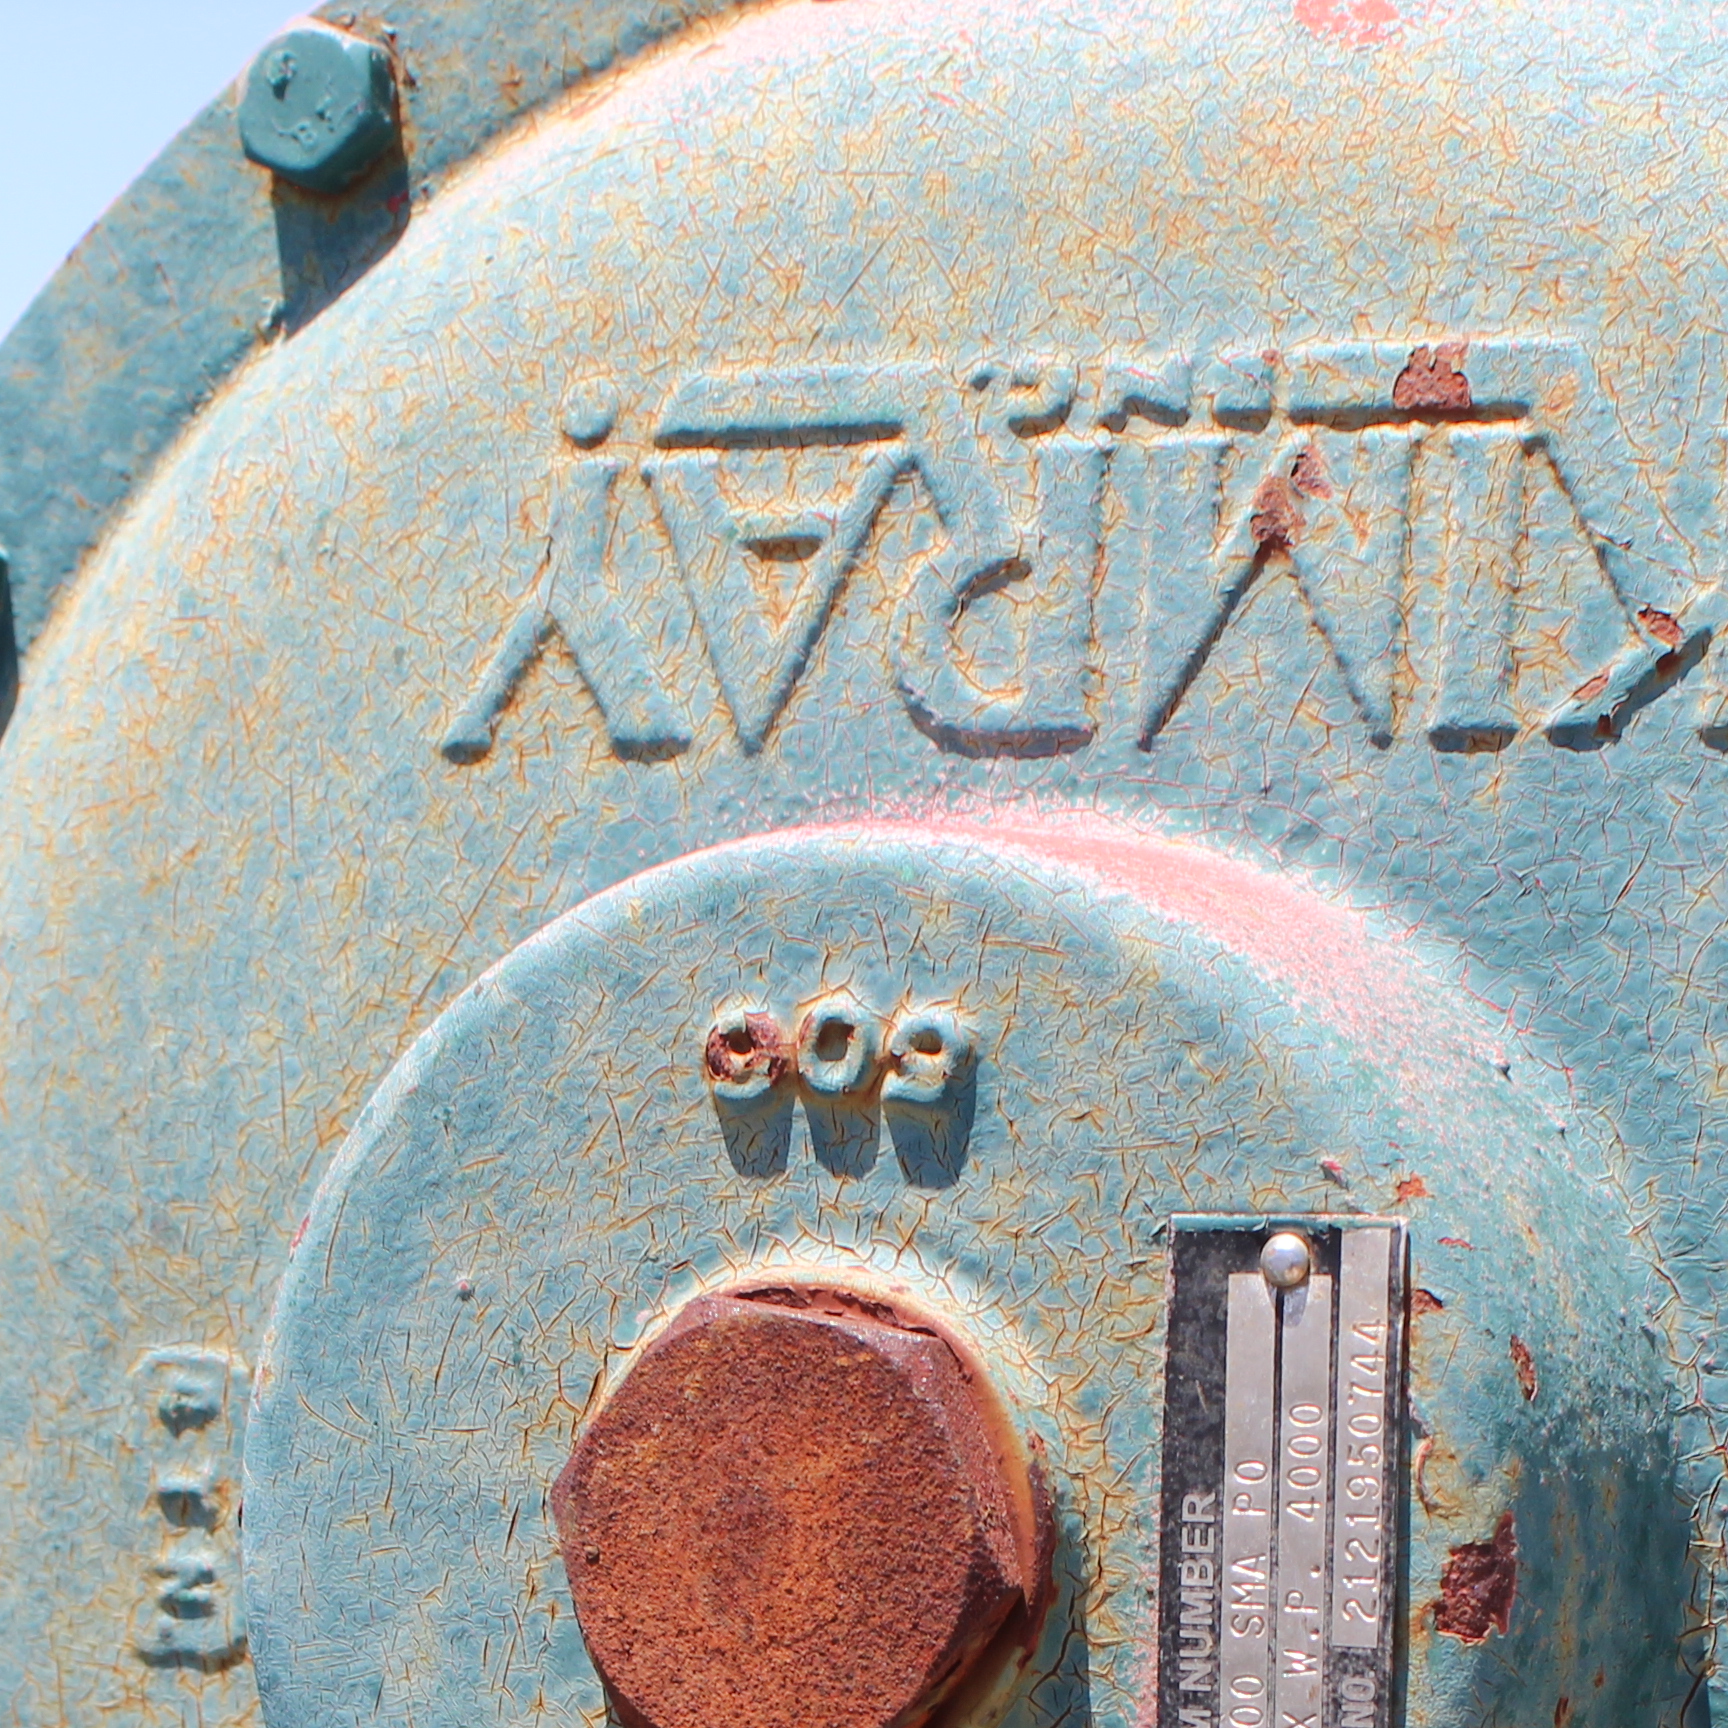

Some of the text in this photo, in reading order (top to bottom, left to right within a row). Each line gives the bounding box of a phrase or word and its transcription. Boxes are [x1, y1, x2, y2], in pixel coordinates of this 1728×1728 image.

[1286, 1399, 1325, 1522] 4000
[1341, 1314, 1388, 1623] 2121950744
[1176, 1491, 1217, 1692] NUMBER
[1229, 1553, 1269, 1639] SMA
[1282, 1560, 1324, 1678] W.P.
